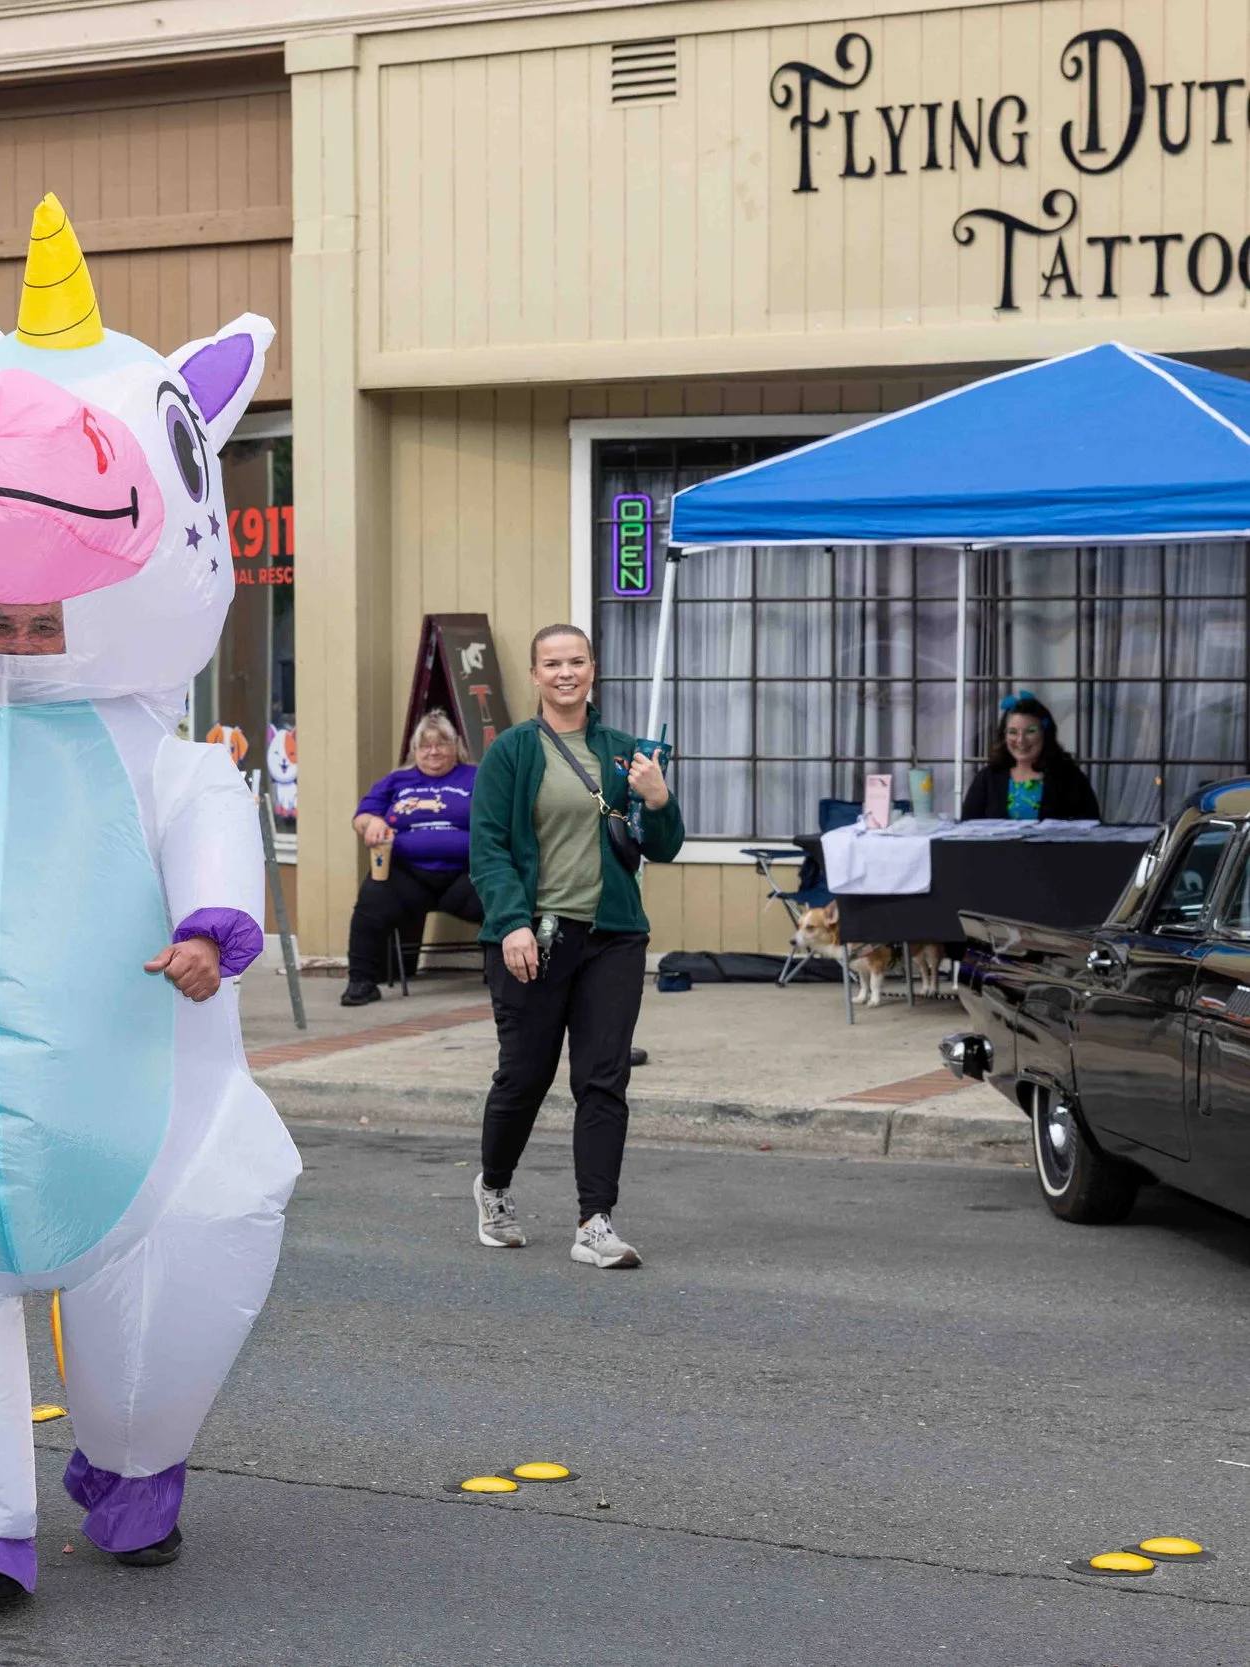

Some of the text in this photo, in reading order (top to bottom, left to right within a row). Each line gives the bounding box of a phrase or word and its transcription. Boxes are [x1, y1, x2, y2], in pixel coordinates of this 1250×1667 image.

[770, 28, 1250, 194] FLYING DUT
[953, 189, 1250, 310] TATTO
[258, 566, 294, 584] RESC
[619, 501, 645, 589] OPEN
